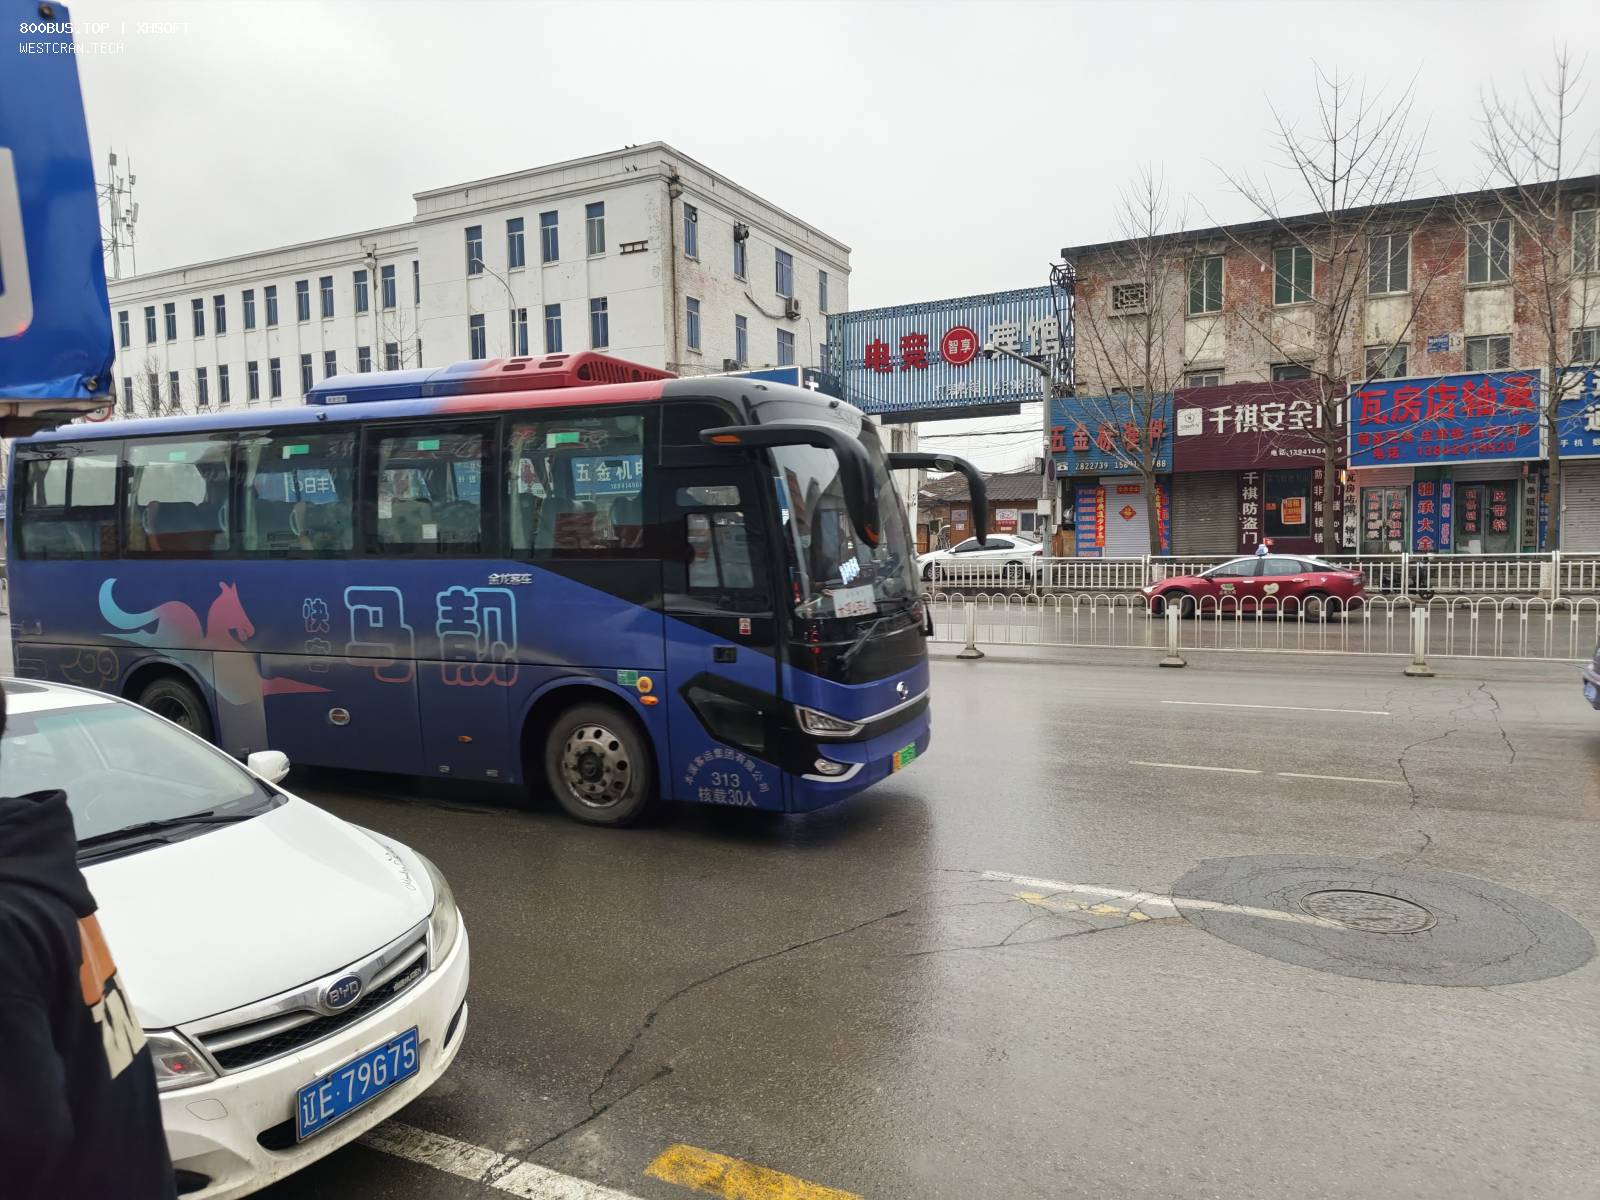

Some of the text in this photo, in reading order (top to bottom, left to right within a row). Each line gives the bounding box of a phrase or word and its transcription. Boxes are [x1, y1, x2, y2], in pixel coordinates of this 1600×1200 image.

[865, 332, 930, 374] 电竞
[947, 339, 972, 355] 智享
[1075, 462, 1109, 471] 2822739
[1242, 471, 1259, 545] 千祺防盗门
[711, 771, 740, 788] 313
[329, 981, 360, 1004] BYD
